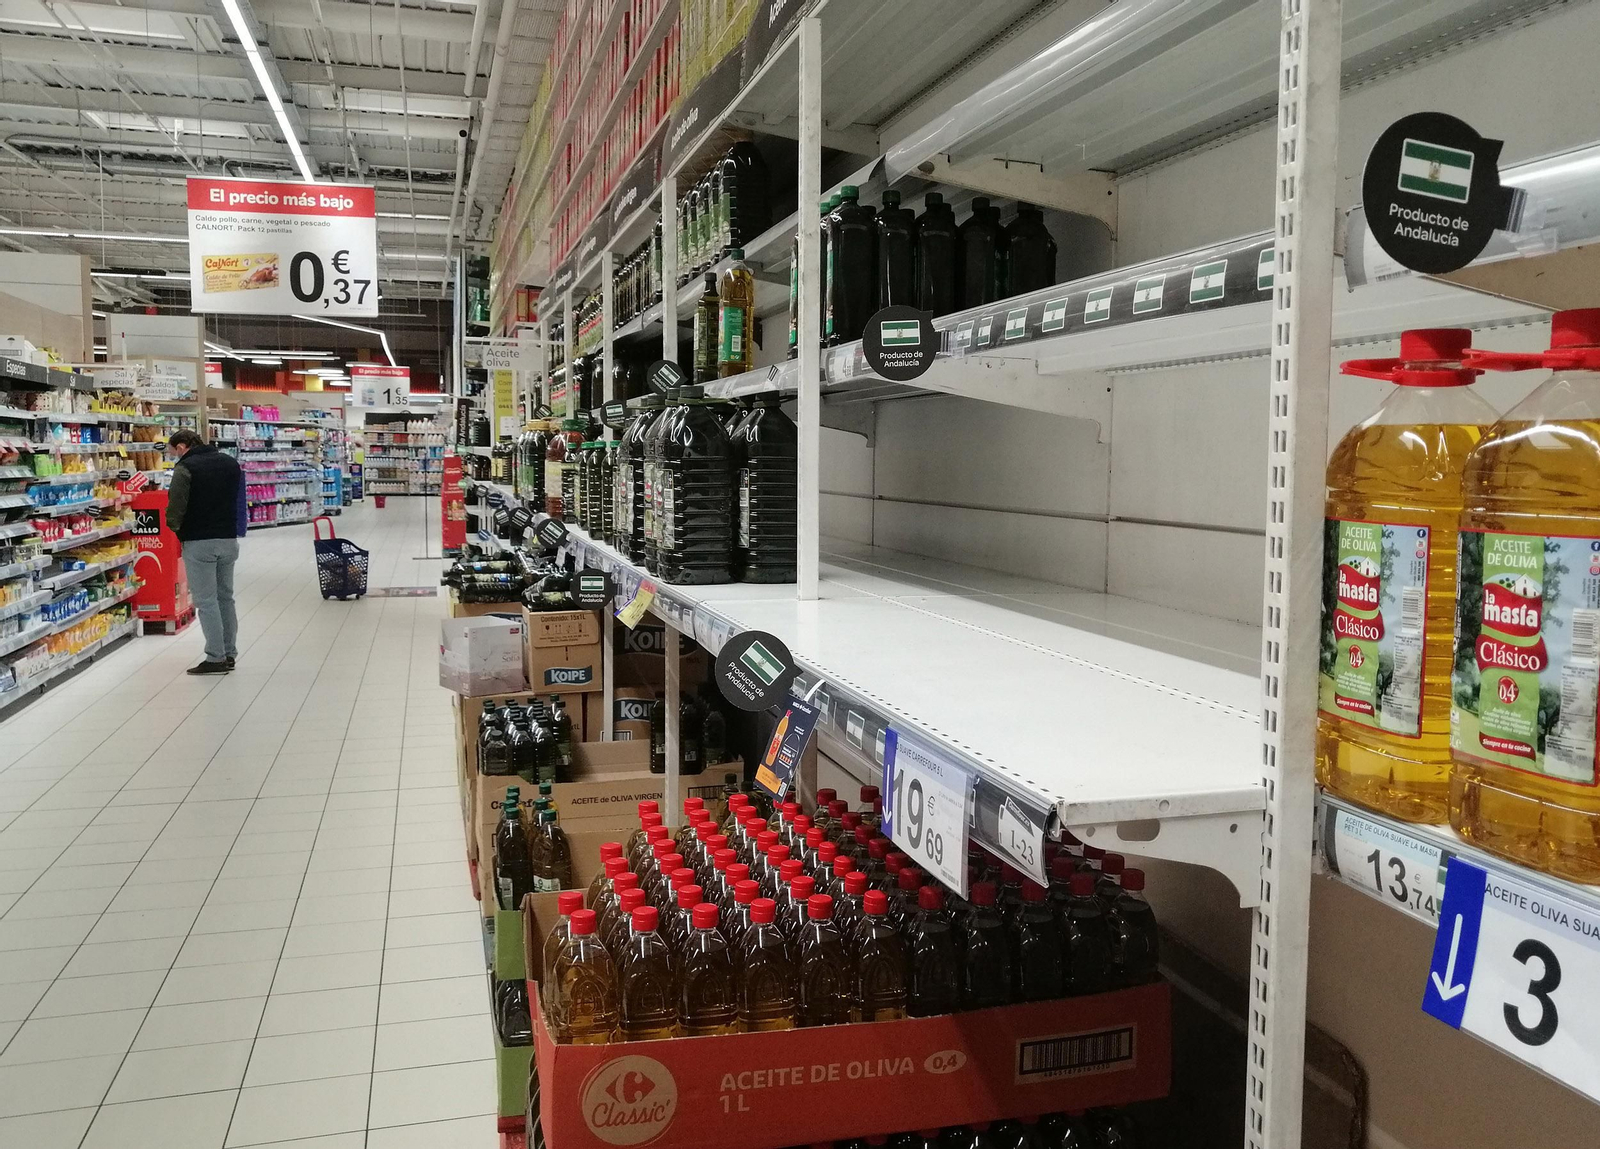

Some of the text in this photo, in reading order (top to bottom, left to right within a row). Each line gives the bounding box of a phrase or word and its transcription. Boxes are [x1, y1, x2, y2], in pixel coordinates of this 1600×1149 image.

[210, 188, 354, 211] El precio más bajo
[195, 214, 217, 223] Caldo
[219, 216, 240, 224] pollo,
[241, 217, 263, 226] carne,
[266, 218, 292, 228] vegetal
[300, 220, 331, 229] pescado
[1389, 203, 1469, 231] Producto de
[237, 225, 256, 233] Pack
[266, 227, 293, 235] pastillas
[1393, 222, 1459, 247] Andalucía
[486, 348, 519, 358] Aceite
[6, 360, 26, 376] Especias
[486, 358, 510, 367] oliva
[101, 378, 134, 386] especias
[1345, 526, 1373, 540] ACEITE
[1341, 538, 1377, 552] DE OLIVA
[1494, 539, 1531, 554] ACEITE
[1487, 552, 1538, 569] DE OLIVA
[1339, 570, 1347, 584] la
[1339, 580, 1378, 603] masía
[1485, 590, 1495, 605] la
[1484, 602, 1538, 628] masía
[1336, 615, 1379, 640] Clásico
[1480, 641, 1540, 671] Clásico
[550, 670, 586, 683] KOIPE
[728, 661, 765, 698] Producto de
[725, 671, 756, 701] Andalucía
[1482, 738, 1501, 748] Siempre
[1514, 744, 1531, 753] cocina
[571, 797, 599, 805] ACEITE
[610, 795, 633, 803] OLIVA
[634, 792, 663, 801] VIRGEN
[893, 768, 935, 850] 19 €
[1344, 823, 1354, 833] PET
[925, 827, 943, 866] 69
[1345, 817, 1438, 858] ACEITE DE OLIVA SUAVE LA MASIA
[1485, 882, 1527, 910] ACEITE
[1531, 901, 1569, 928] OLIVA
[1503, 938, 1562, 1046] 3
[720, 1053, 957, 1091] ACEITE DE OLIVA 0,4
[719, 1094, 750, 1113] 1 L
